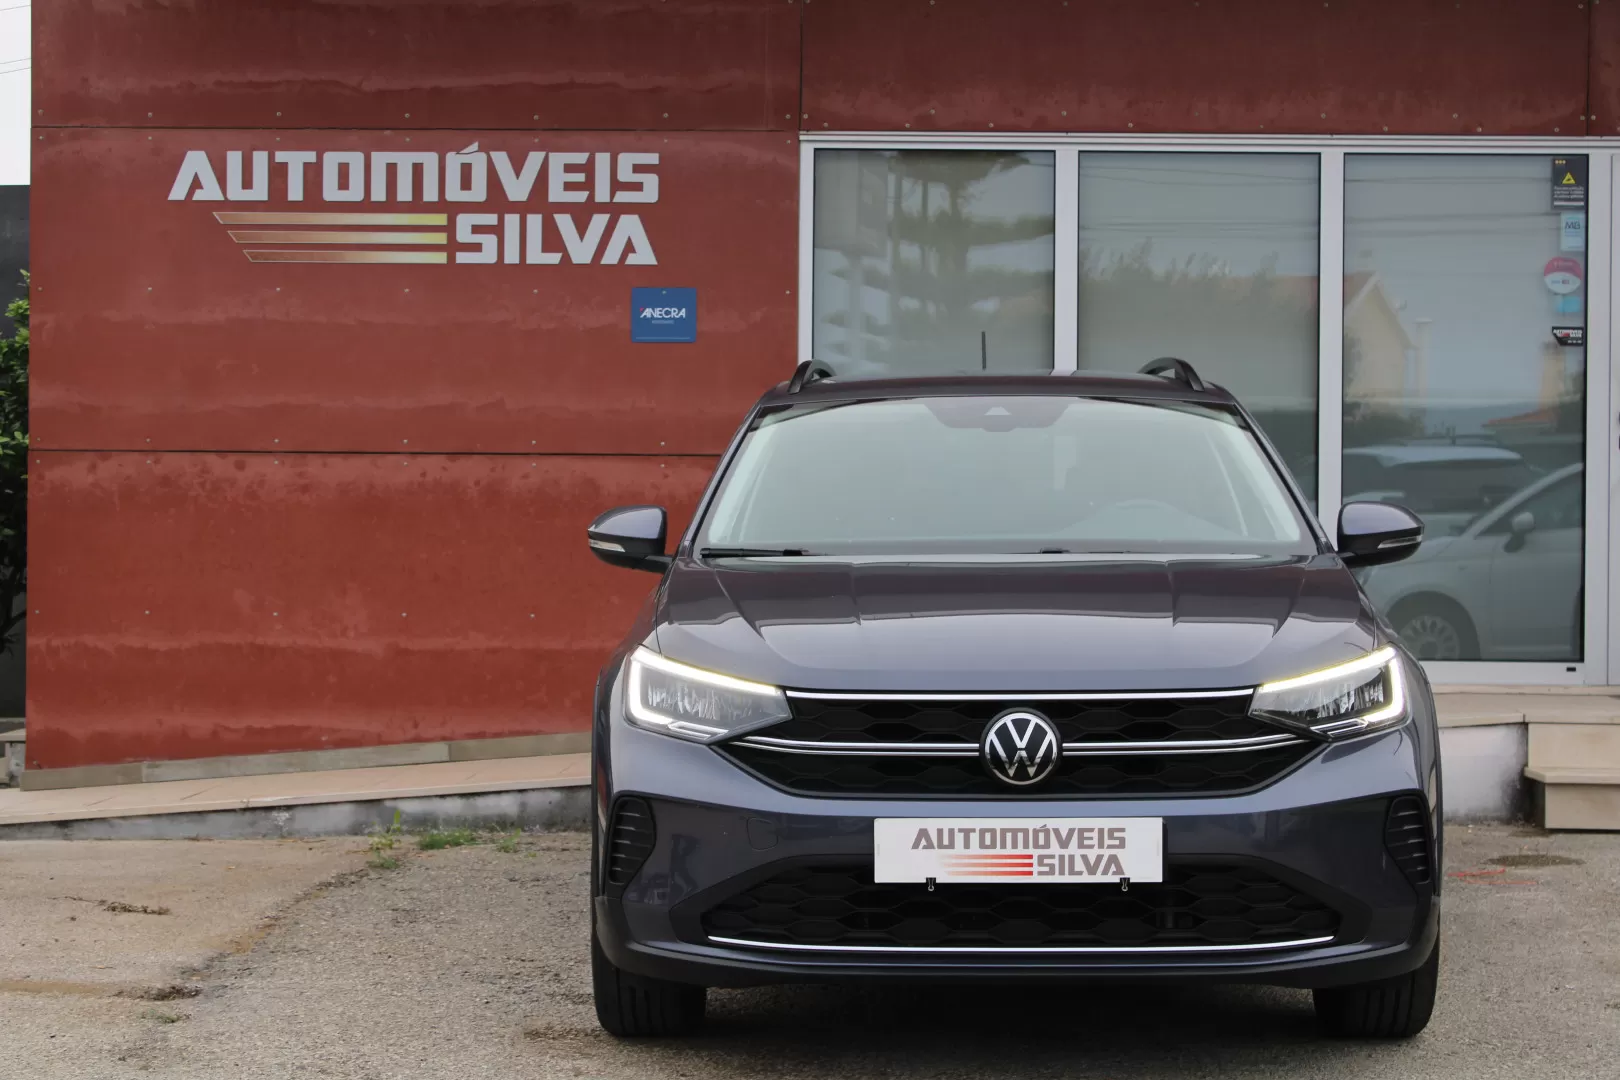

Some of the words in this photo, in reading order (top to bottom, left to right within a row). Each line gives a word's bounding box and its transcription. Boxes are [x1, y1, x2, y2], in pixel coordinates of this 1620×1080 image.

[167, 141, 660, 204] AUTOMÓVEIS
[454, 213, 659, 266] SILVA
[640, 307, 687, 319] ANECRA
[910, 823, 1127, 850] AUTOMÓVEIS
[1036, 854, 1126, 877] SILVA
